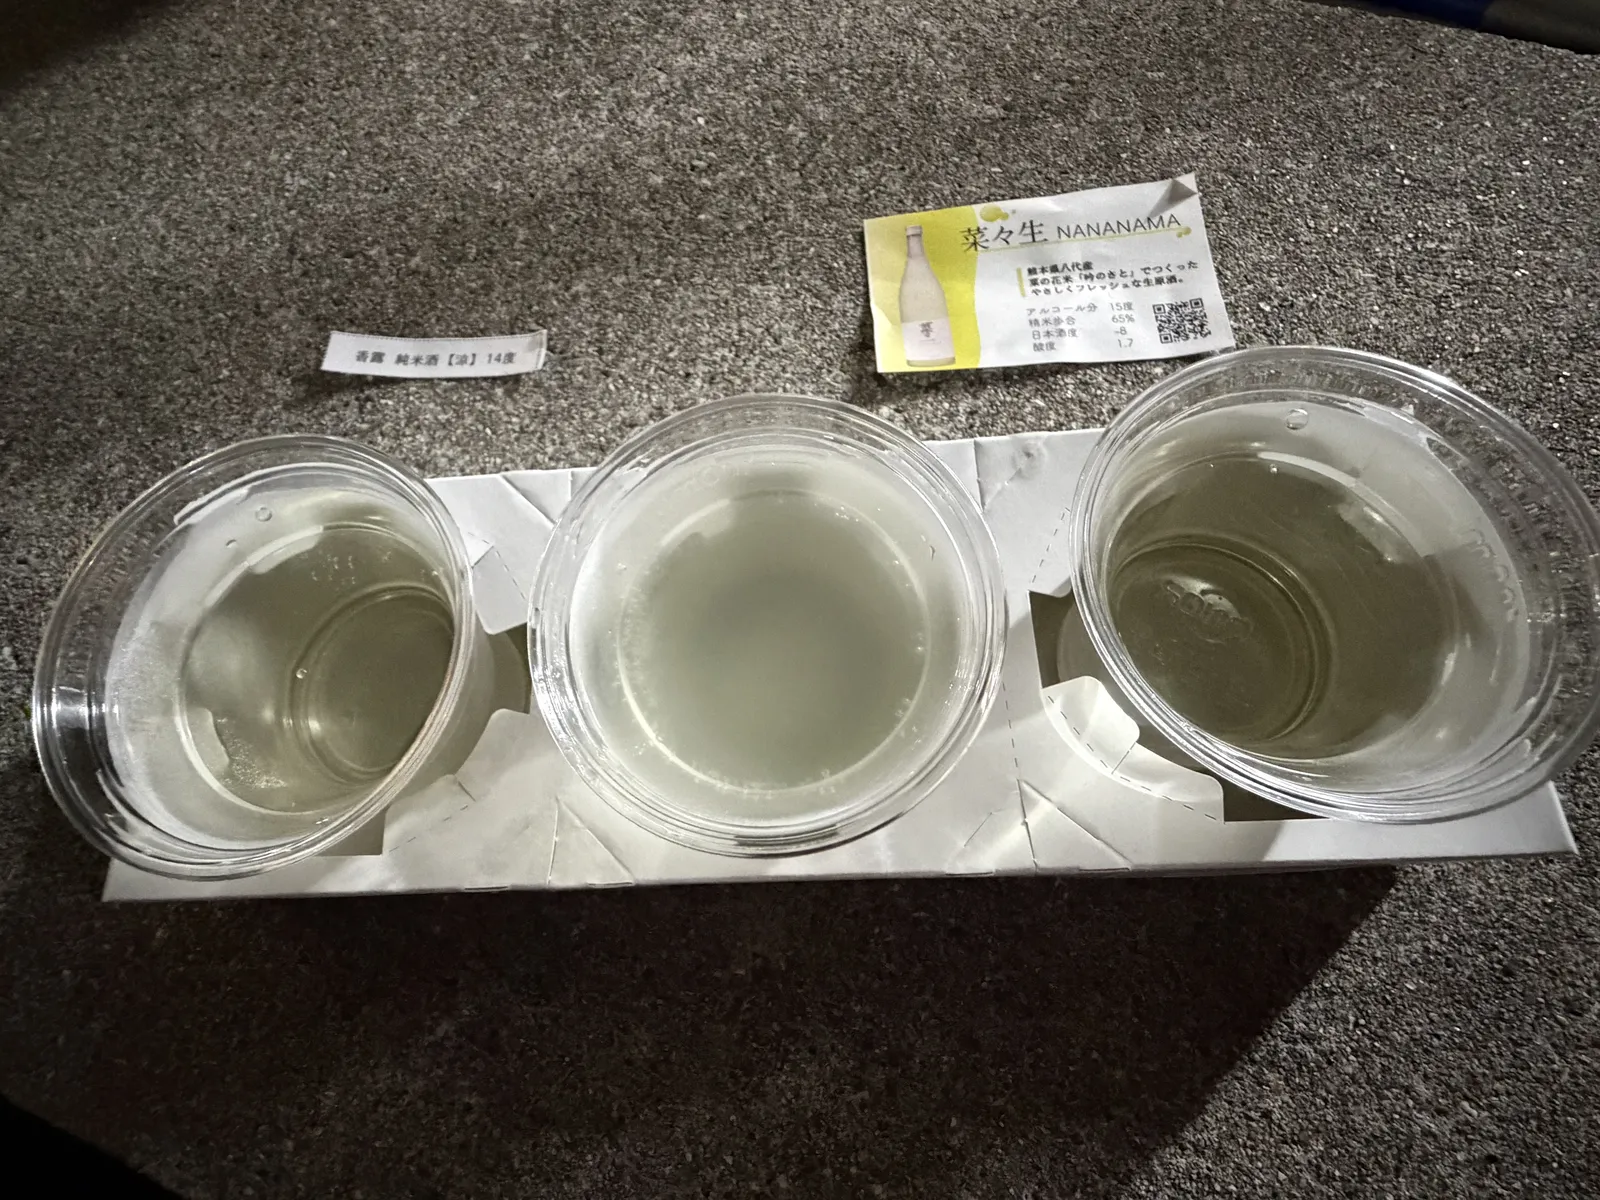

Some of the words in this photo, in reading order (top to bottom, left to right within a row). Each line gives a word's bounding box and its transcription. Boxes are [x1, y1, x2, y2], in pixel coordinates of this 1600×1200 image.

[960, 220, 1049, 253] 菜々生
[1057, 213, 1181, 238] NANANAMA
[1027, 261, 1093, 275] 熊本県八代産
[1031, 276, 1183, 296] やさしくフレッシュな生原酒。
[1026, 302, 1098, 315] アルコール分
[1110, 302, 1134, 311] 15度
[1029, 316, 1076, 327] 精米歩合
[1111, 314, 1135, 323] 65%
[1032, 329, 1078, 340] 日本酒度
[1033, 342, 1056, 352] 酸度
[1118, 339, 1133, 348] 1.7
[356, 350, 385, 364] 香露
[395, 353, 438, 367] 純米酒
[487, 352, 516, 364] 14度
